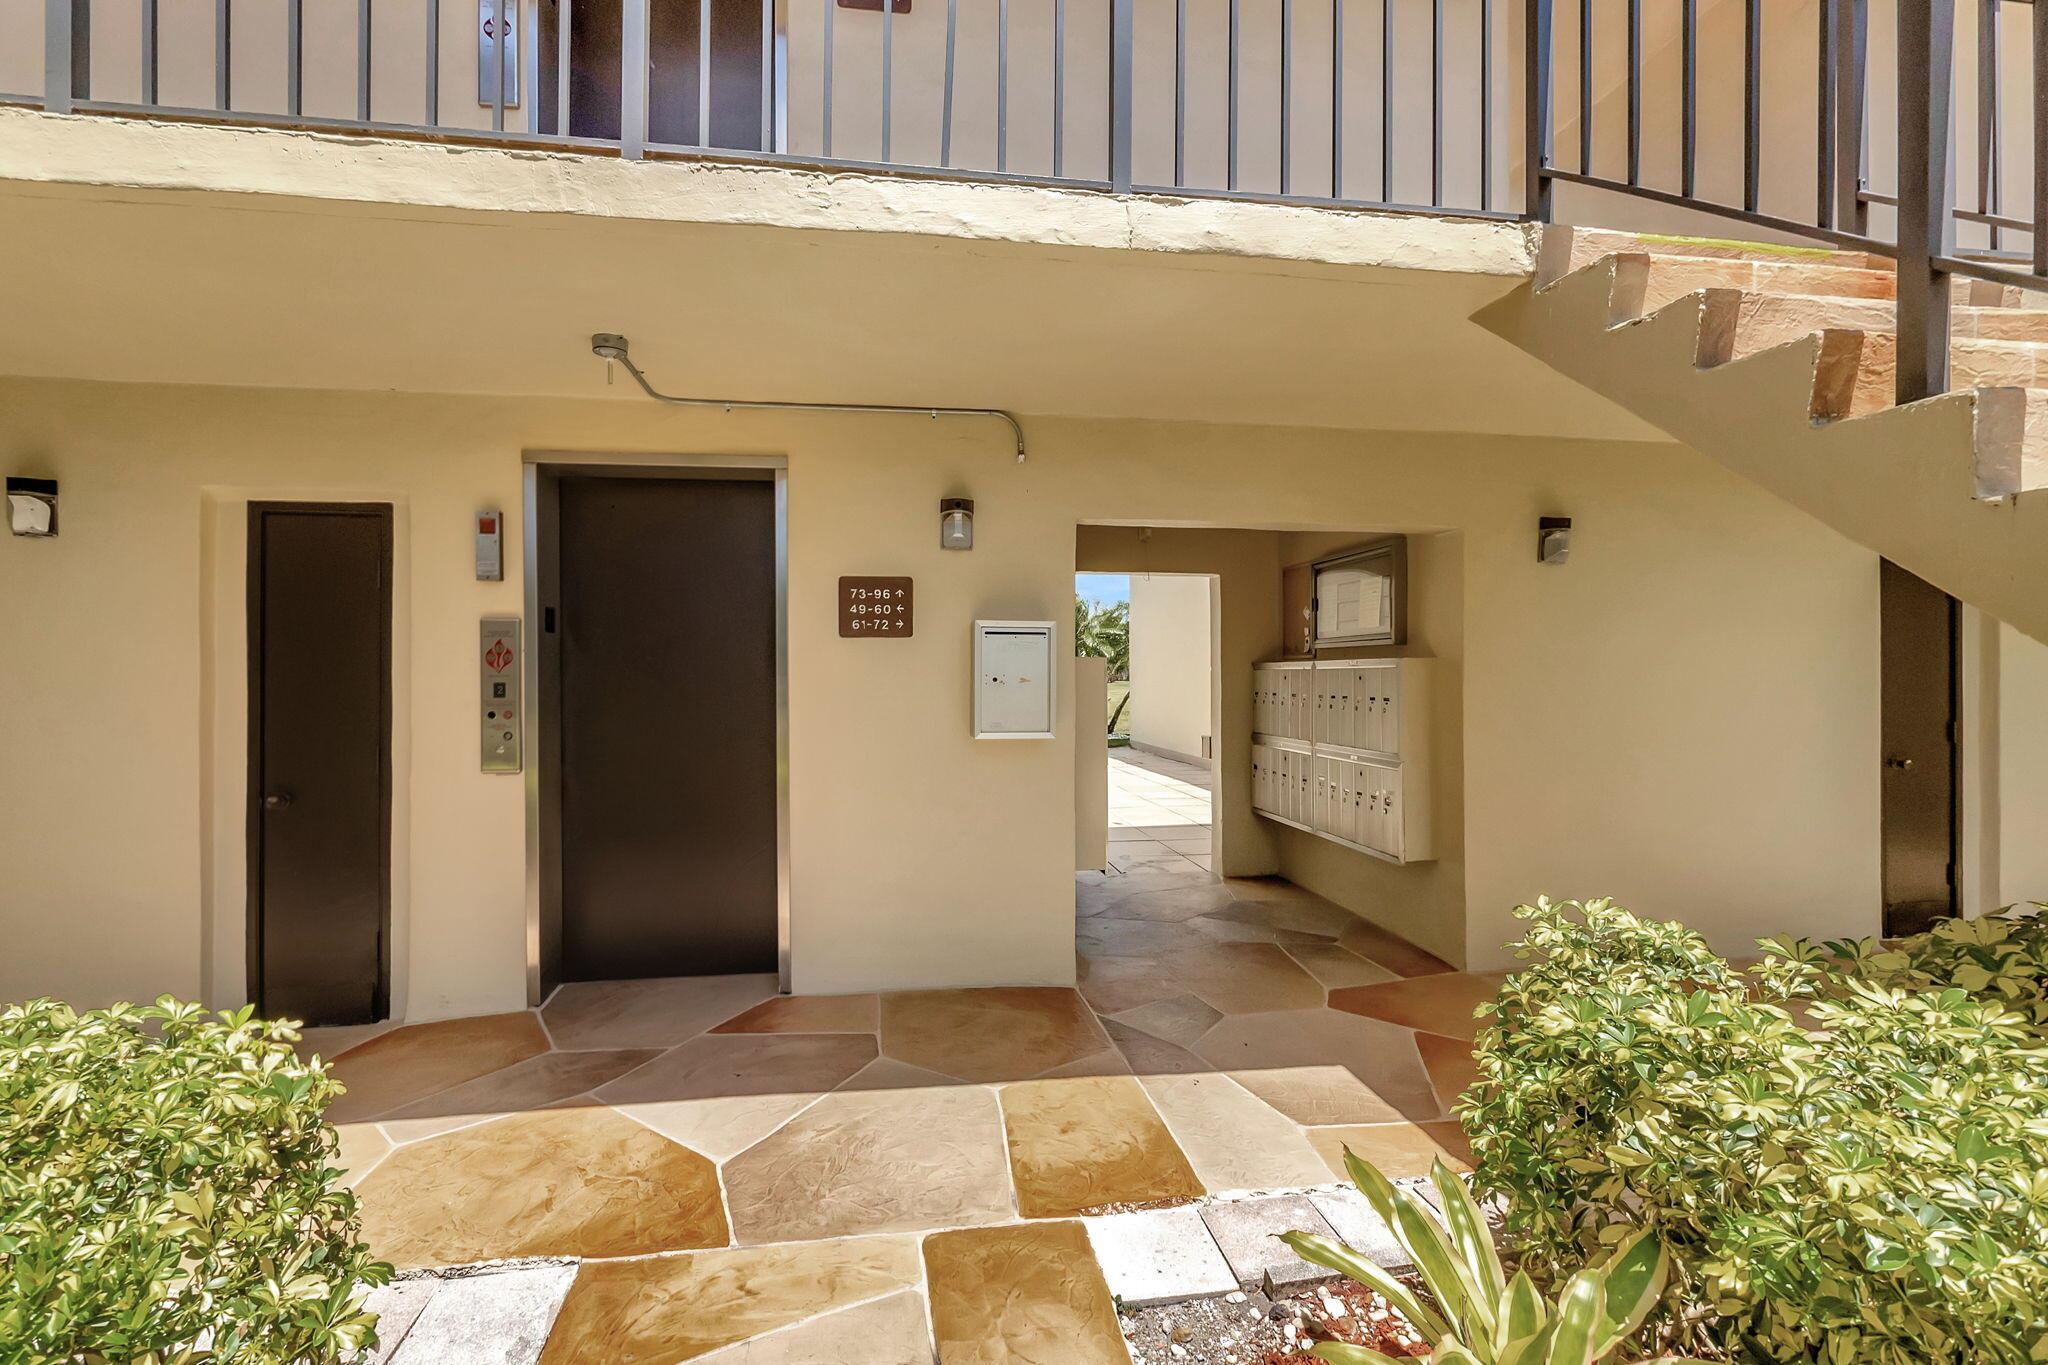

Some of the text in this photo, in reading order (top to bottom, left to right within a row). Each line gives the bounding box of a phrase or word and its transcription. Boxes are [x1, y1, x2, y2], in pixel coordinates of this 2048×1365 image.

[850, 588, 891, 599] 73-96
[849, 604, 891, 614] 49-60
[852, 619, 889, 630] 61-72
